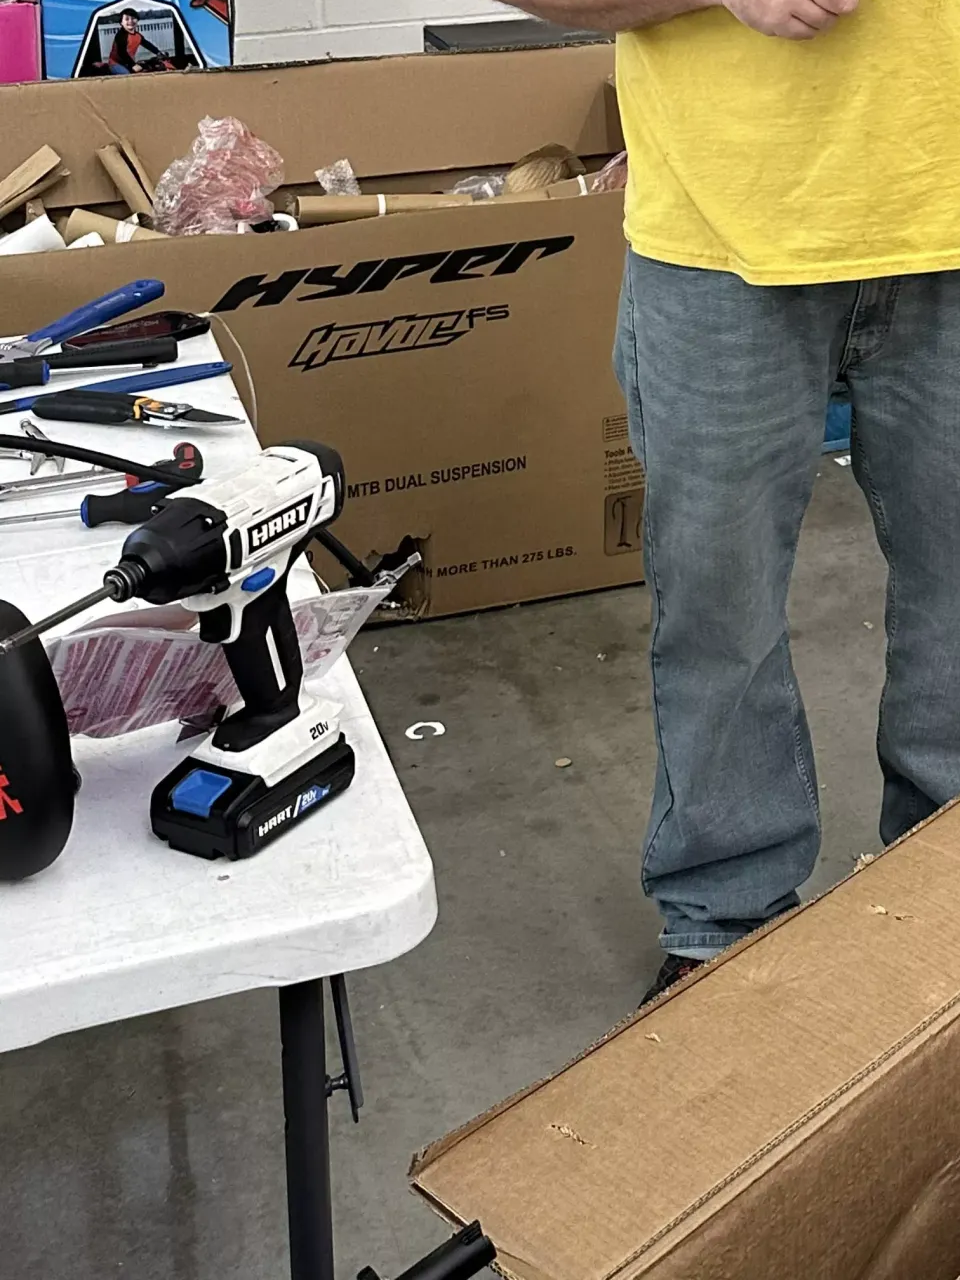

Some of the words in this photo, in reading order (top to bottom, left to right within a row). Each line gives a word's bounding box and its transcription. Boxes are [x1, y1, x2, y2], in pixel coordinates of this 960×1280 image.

[347, 480, 380, 499] MTB
[384, 473, 427, 493] DUAL
[430, 455, 527, 485] SUSPENSION
[251, 501, 308, 548] HART
[436, 562, 477, 578] MORE
[481, 555, 519, 571] THAN
[521, 550, 544, 565] 275
[547, 545, 578, 560] LBS.
[258, 805, 293, 837] HART
